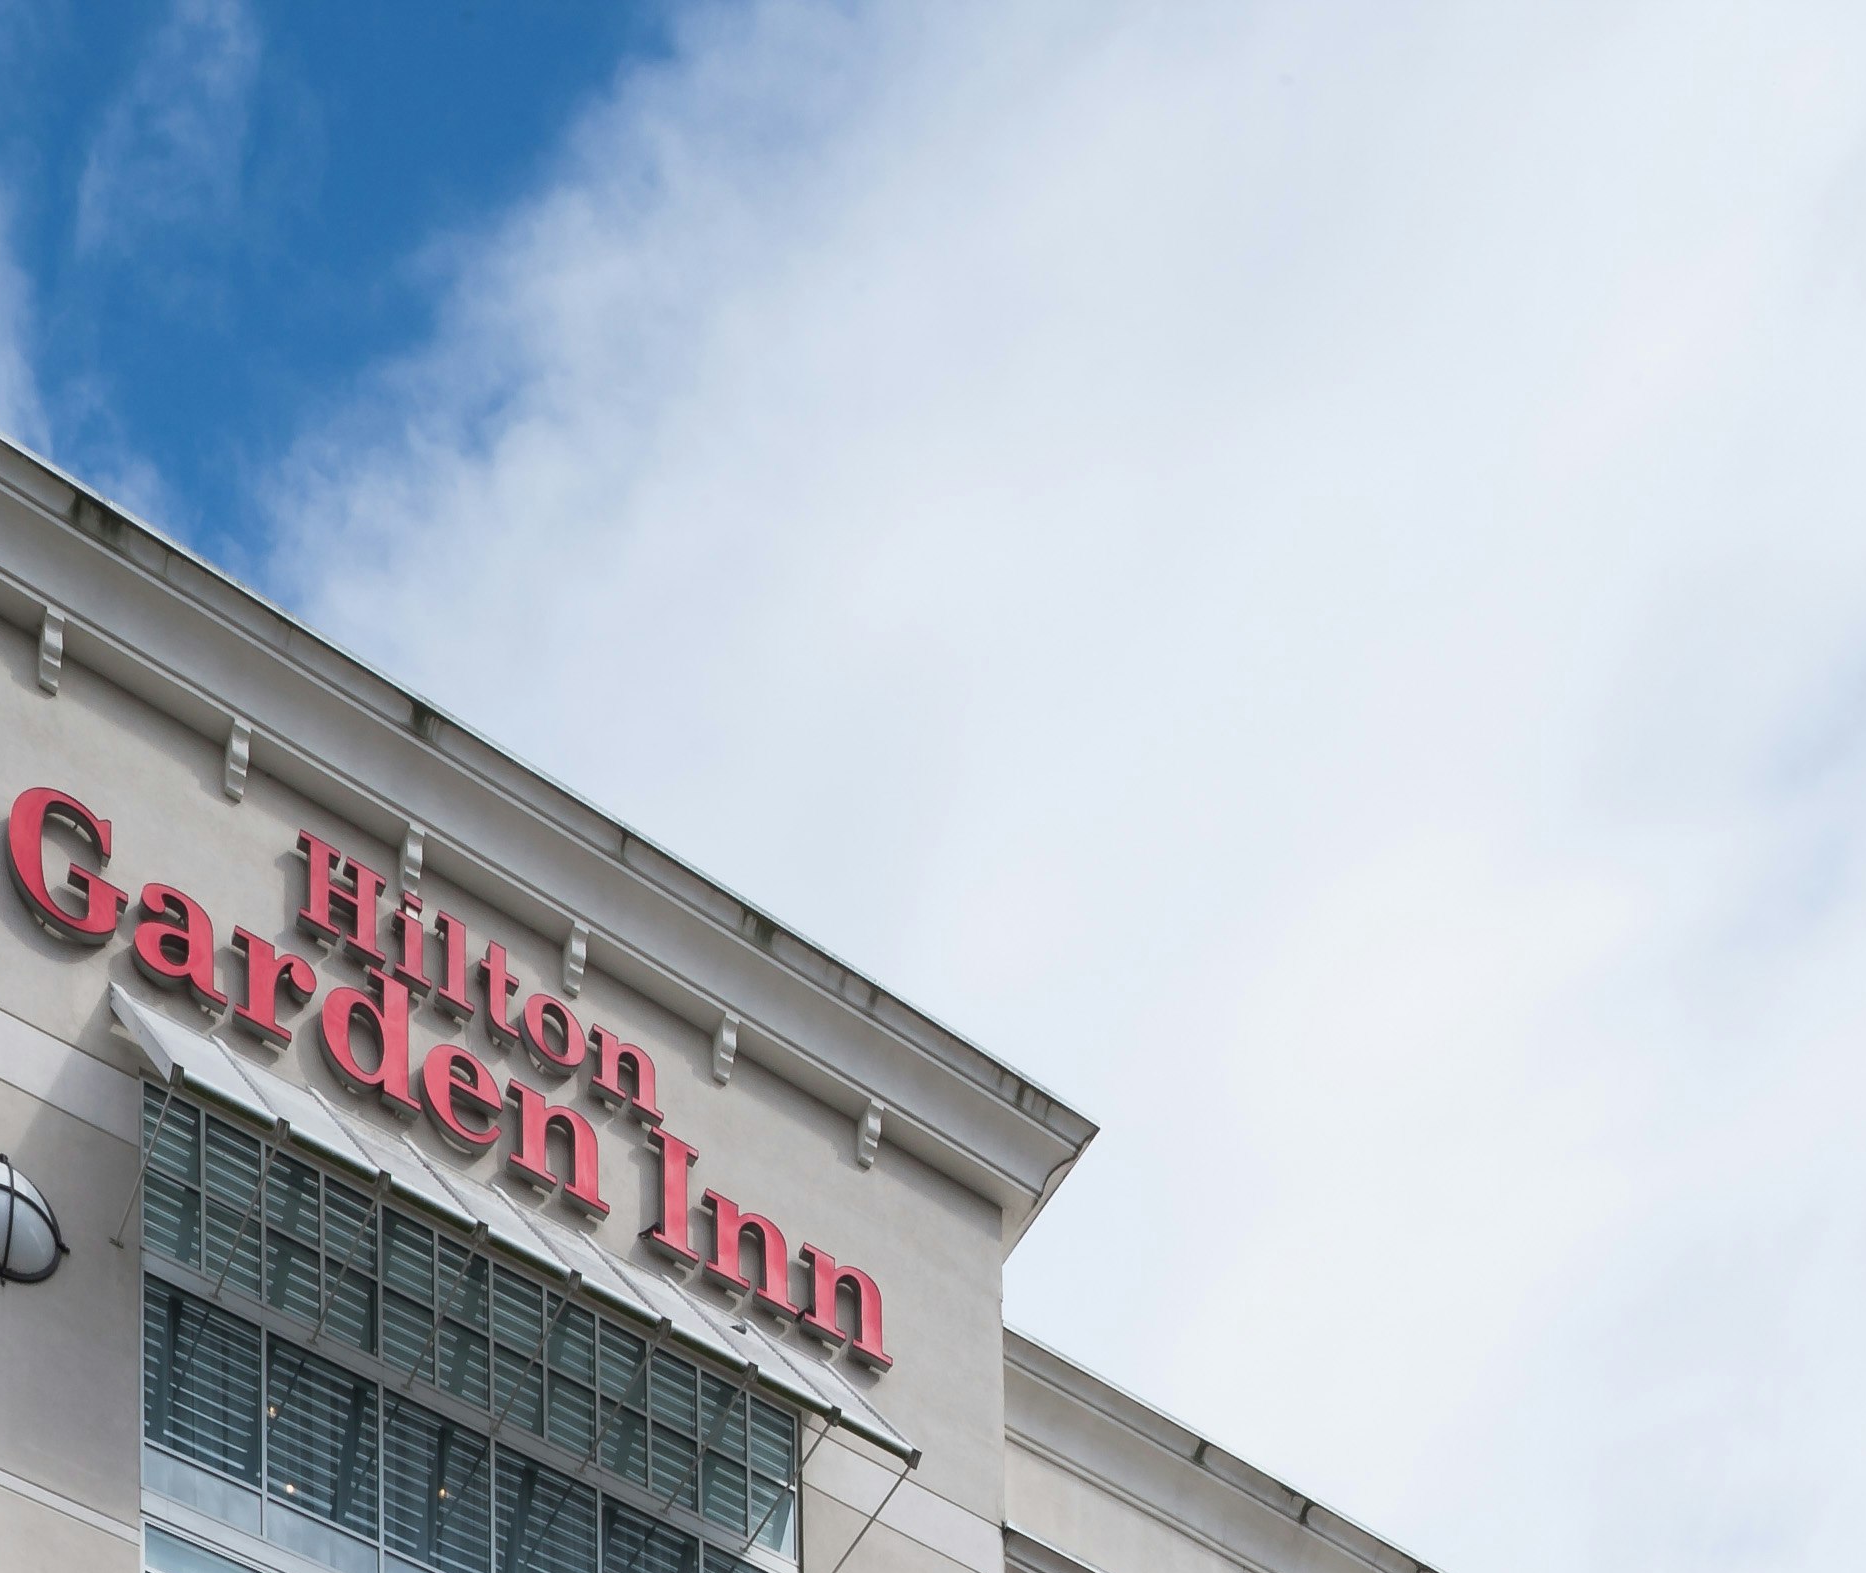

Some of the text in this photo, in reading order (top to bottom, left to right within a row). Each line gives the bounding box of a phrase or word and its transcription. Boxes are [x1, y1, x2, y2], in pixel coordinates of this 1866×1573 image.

[6, 786, 893, 1372] Garden Inn
[297, 829, 664, 1127] Hilton
